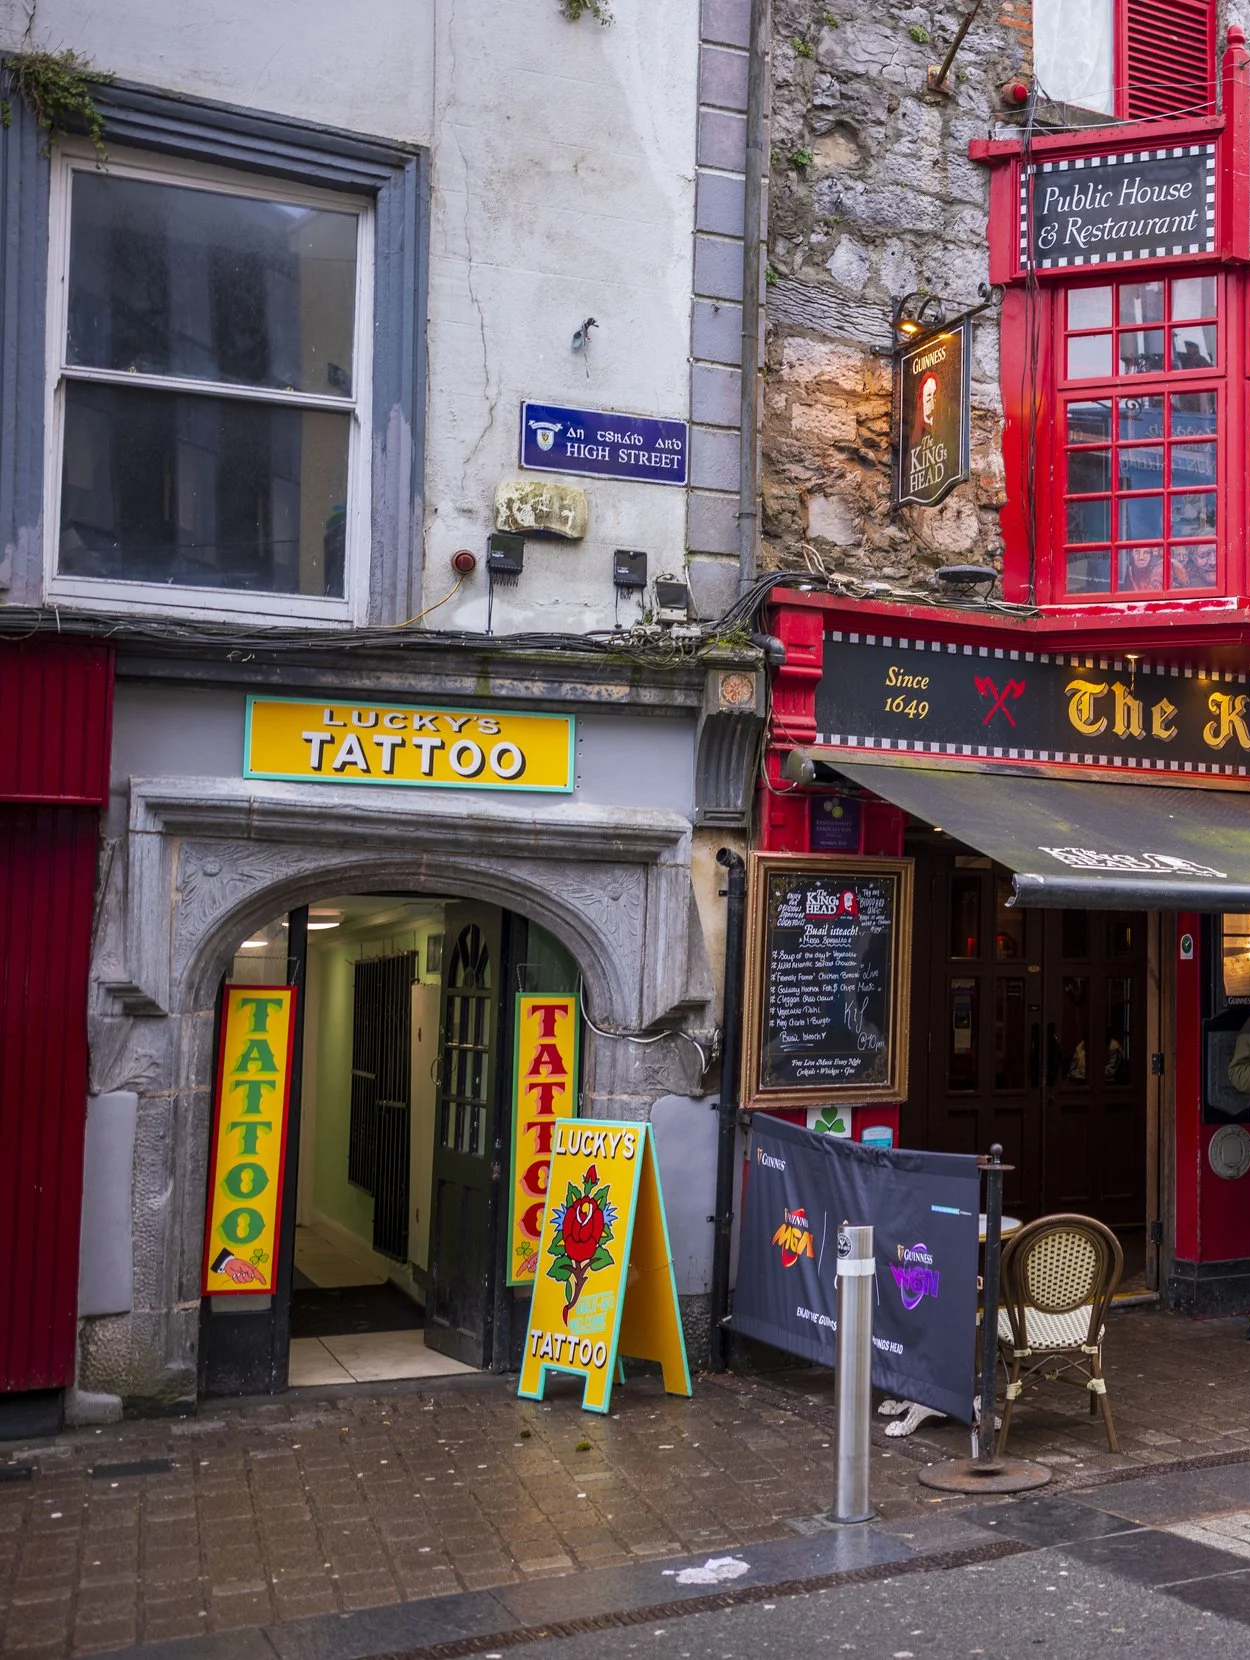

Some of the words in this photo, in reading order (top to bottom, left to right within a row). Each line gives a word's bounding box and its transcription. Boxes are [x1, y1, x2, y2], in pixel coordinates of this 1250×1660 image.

[1043, 183, 1113, 214] Public
[1117, 177, 1192, 206] House
[1038, 223, 1058, 249] &
[1063, 209, 1199, 248] Restaurant
[912, 346, 946, 375] GUINNESS
[566, 443, 610, 460] HIGH
[619, 449, 681, 469] STREET
[922, 435, 934, 450] The
[909, 464, 945, 493] HEAD
[885, 666, 929, 690] Since
[323, 708, 501, 735] LUCKY'S
[884, 694, 929, 720] 1649
[1064, 679, 1178, 742] The
[302, 731, 526, 779] TATTOO
[806, 904, 836, 914] HEAD
[778, 950, 795, 962] Soup
[216, 998, 284, 1248] TATTOO
[518, 1004, 569, 1241] TATTOO
[555, 1128, 635, 1160] LUCKY'S
[903, 1249, 933, 1264] GUINNESS
[530, 1329, 608, 1369] TATTOO
[890, 1341, 904, 1355] HEAD
